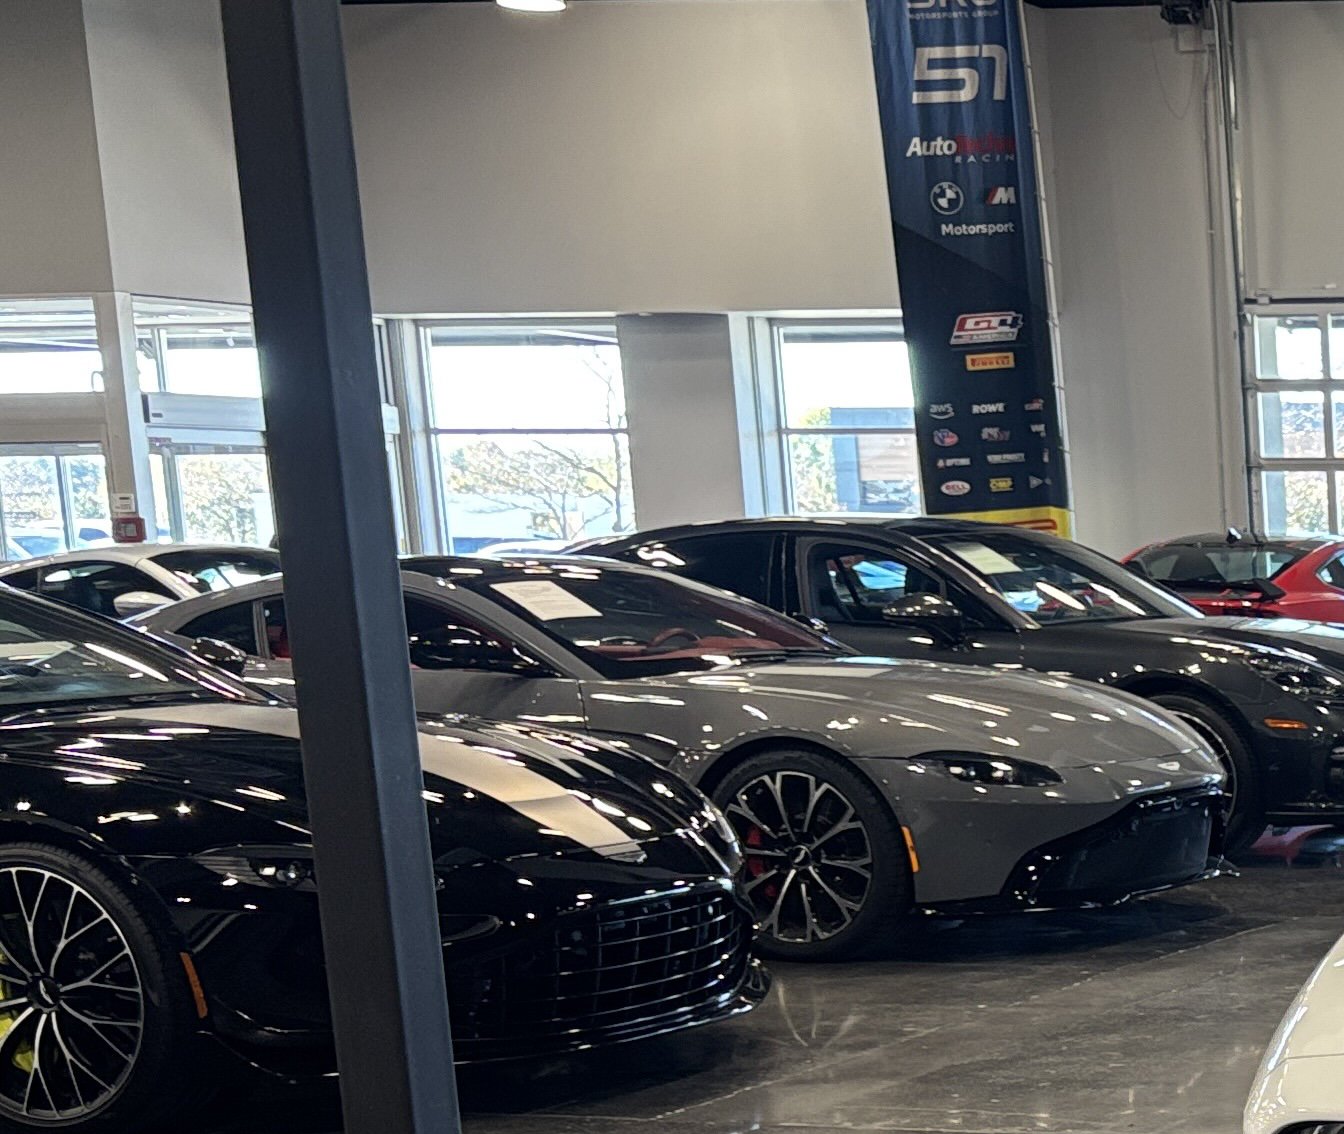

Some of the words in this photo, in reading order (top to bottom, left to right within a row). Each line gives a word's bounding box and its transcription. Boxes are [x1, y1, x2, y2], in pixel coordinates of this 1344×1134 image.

[912, 44, 1008, 104] 51
[941, 222, 1015, 236] Motorsport
[972, 402, 1005, 414] ROWE
